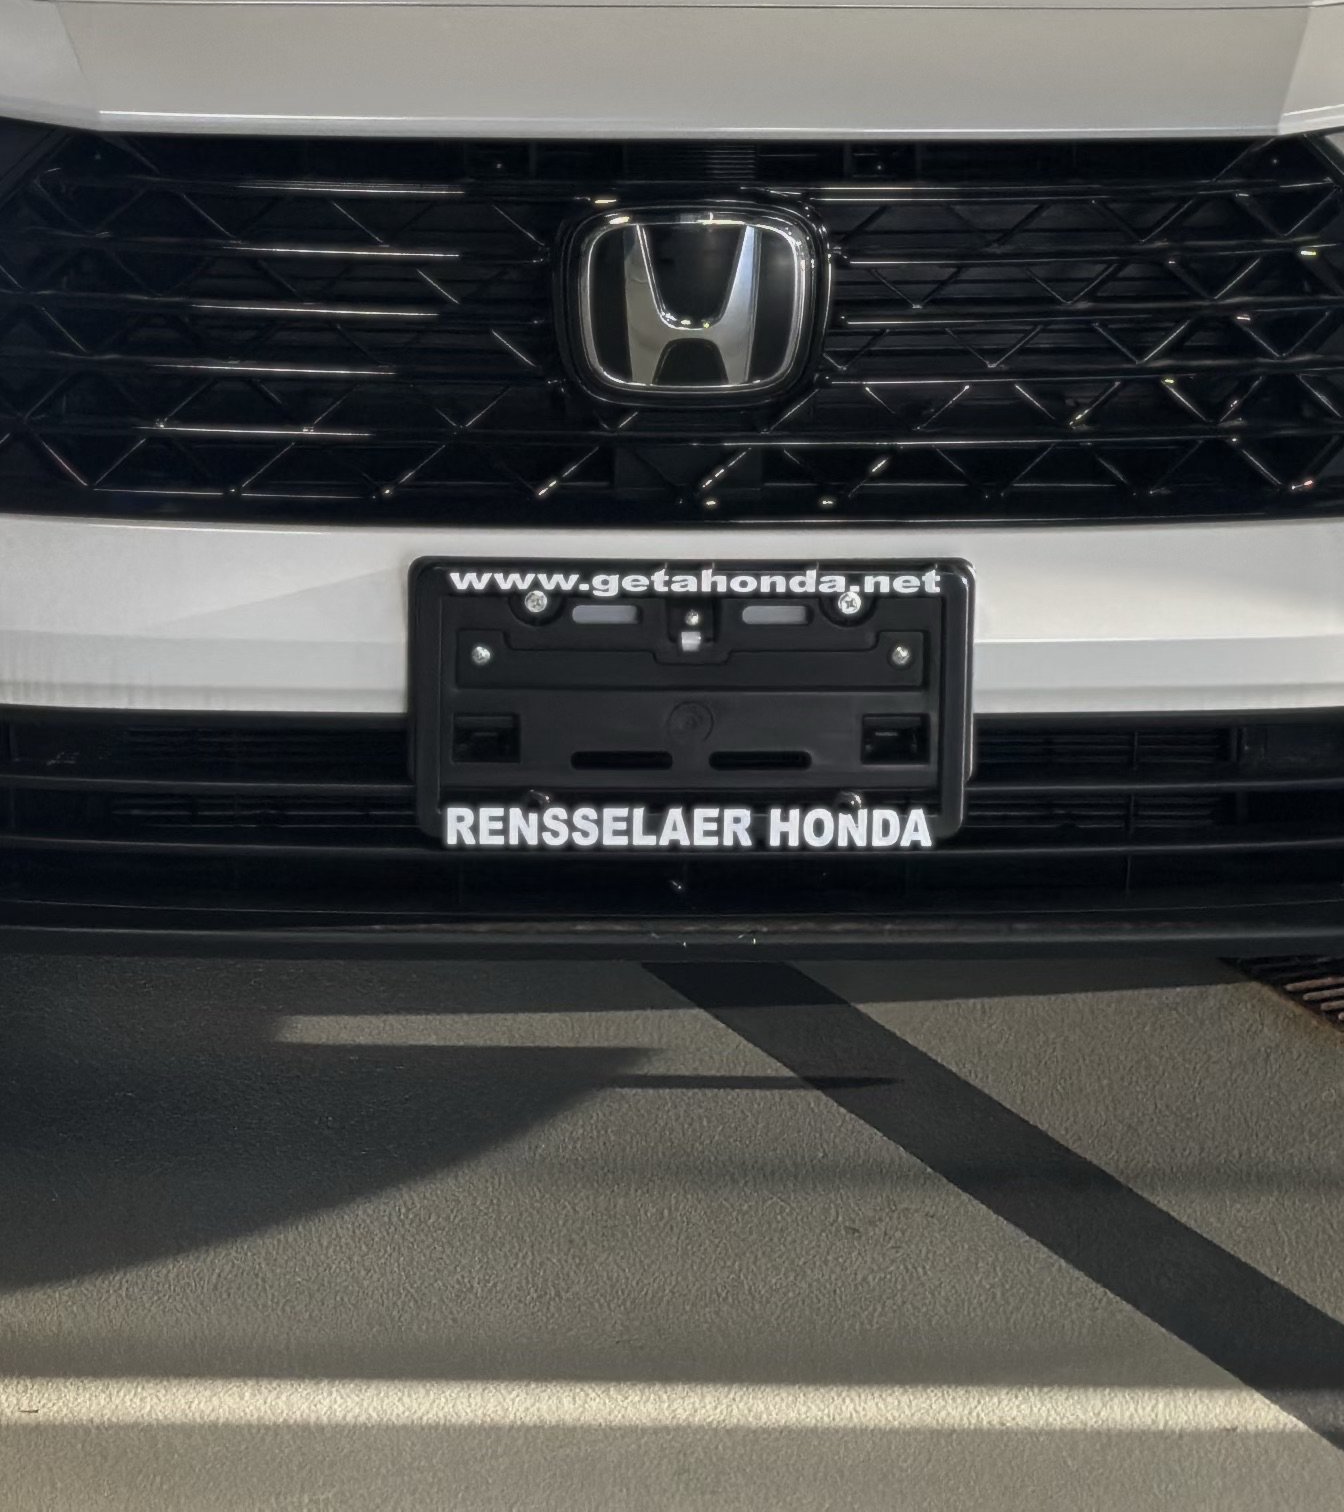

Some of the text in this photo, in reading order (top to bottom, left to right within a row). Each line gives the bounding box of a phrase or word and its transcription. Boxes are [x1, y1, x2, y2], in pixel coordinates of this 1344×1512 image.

[449, 568, 941, 597] www.getahonda.net
[446, 807, 933, 848] RENSSELAER HONDA
